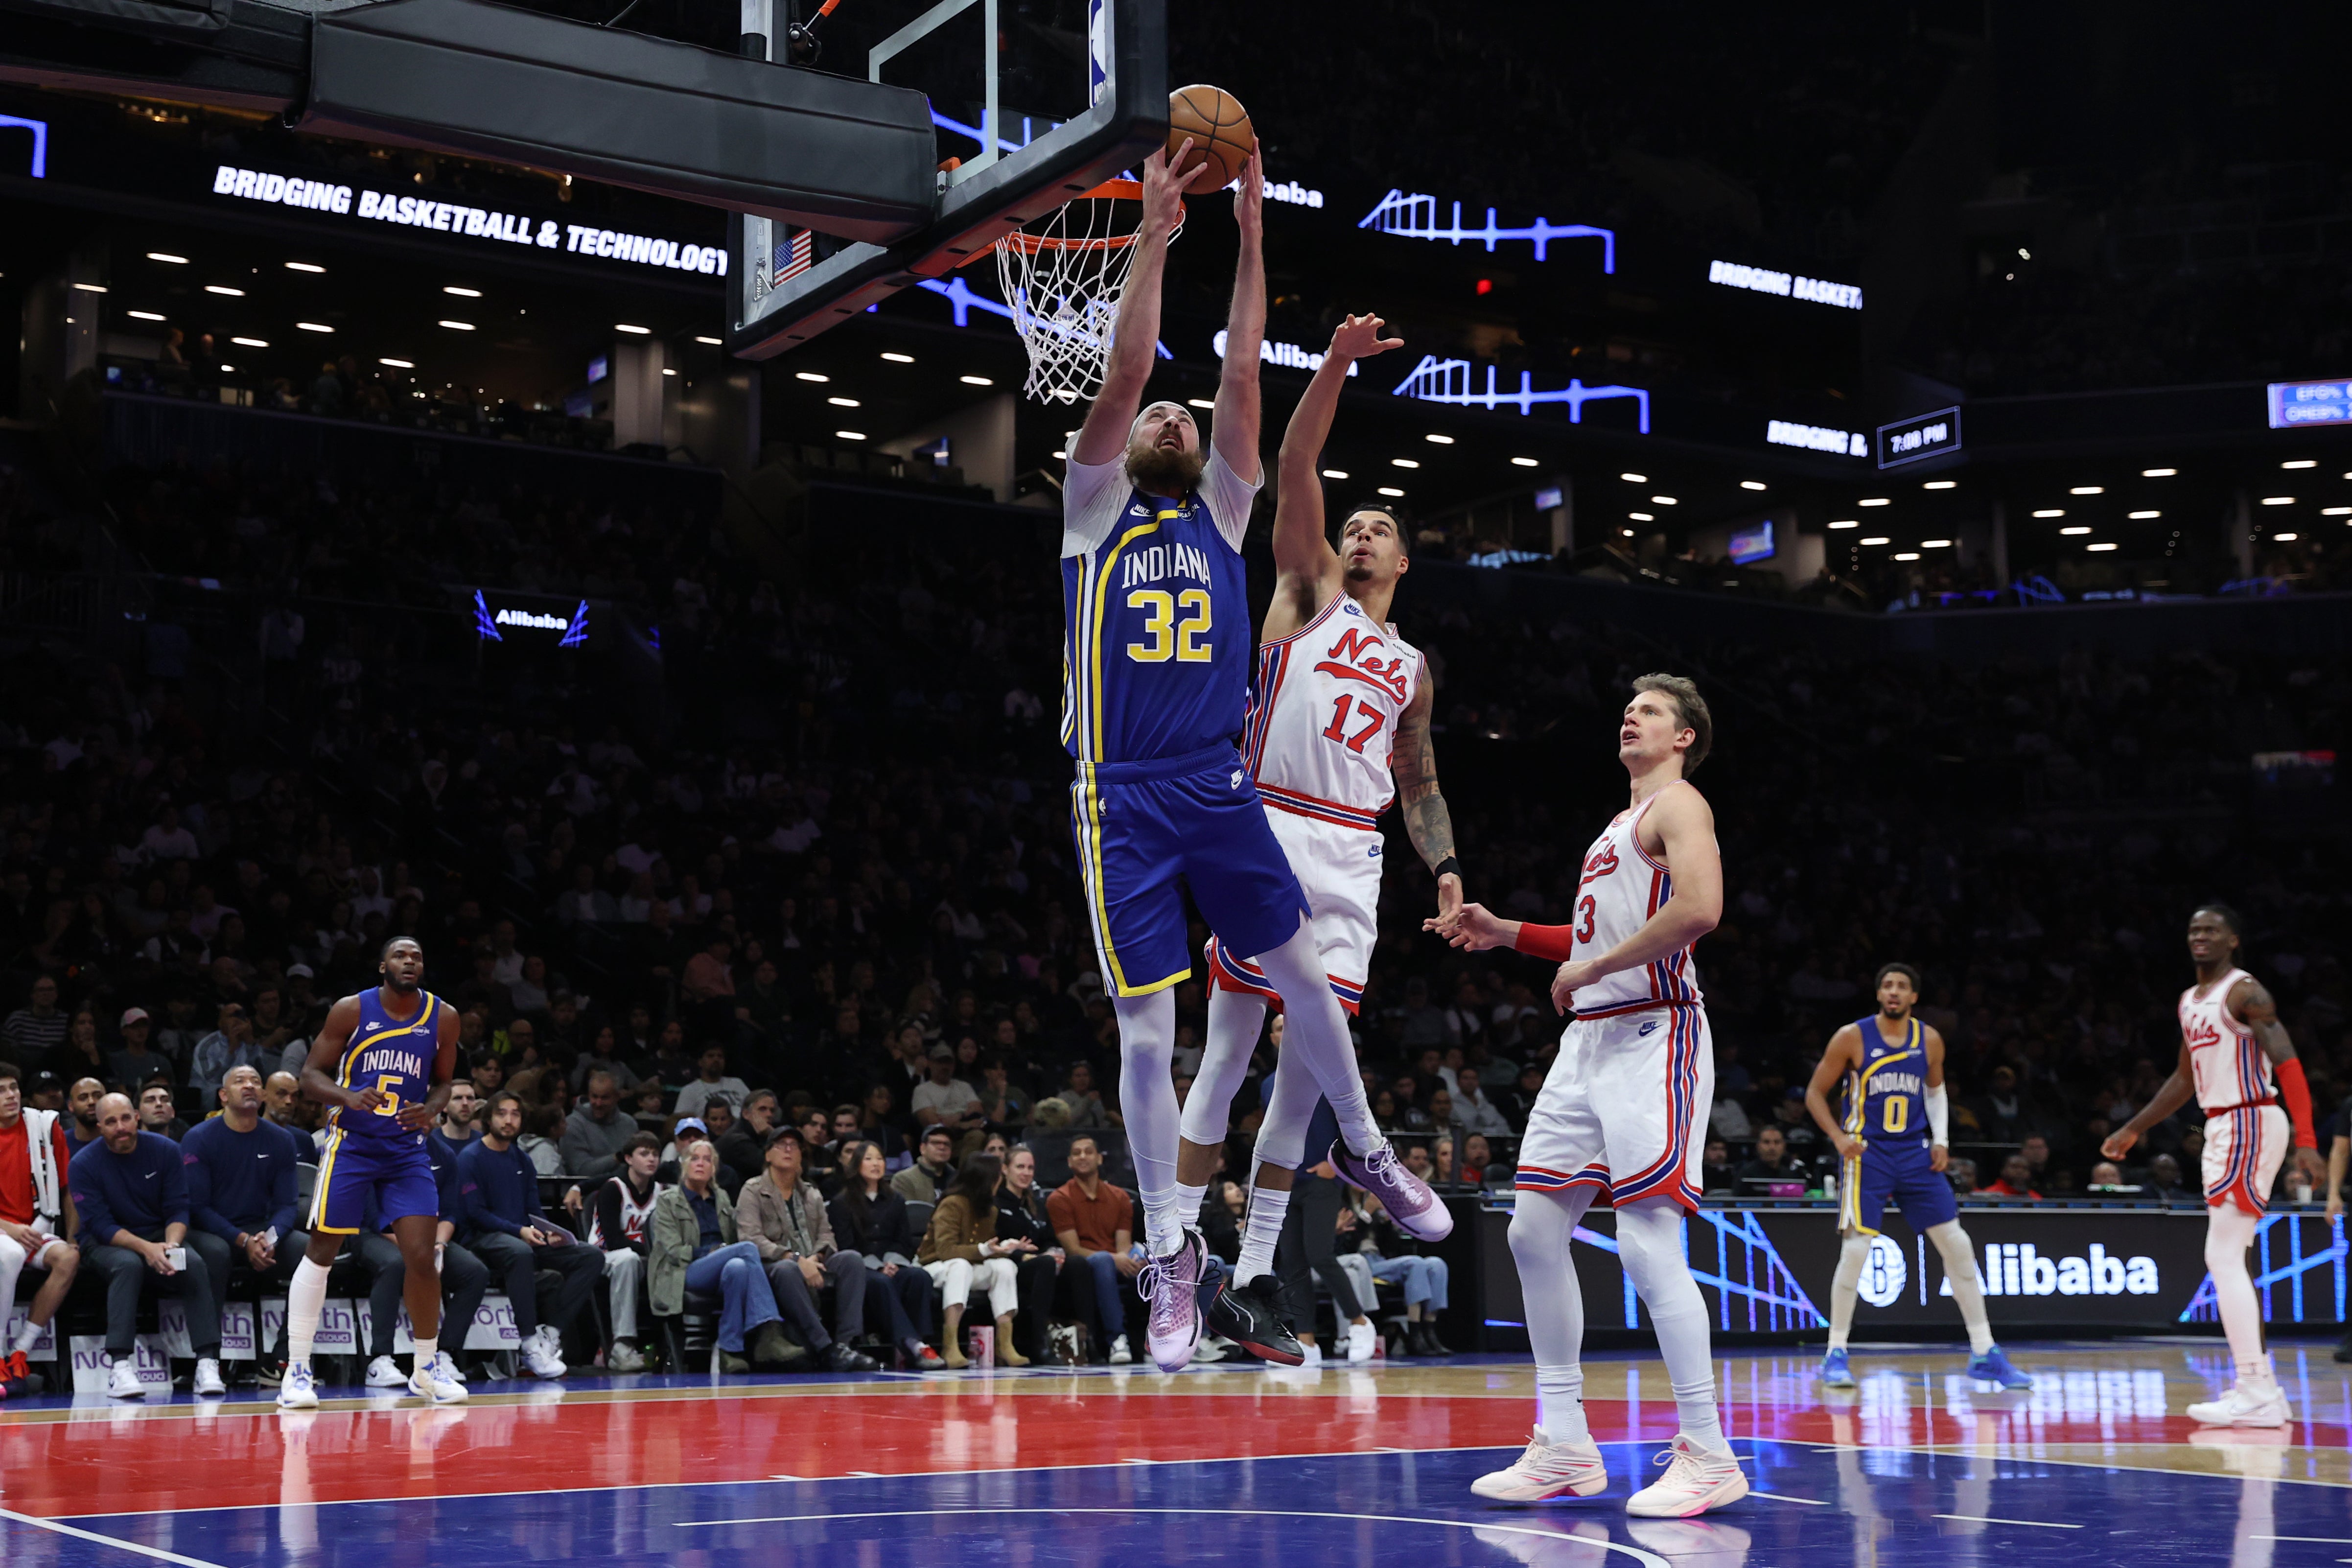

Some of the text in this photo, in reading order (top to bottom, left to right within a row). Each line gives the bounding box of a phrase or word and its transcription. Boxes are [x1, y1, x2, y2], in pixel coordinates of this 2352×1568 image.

[1221, 175, 1324, 209] baba
[212, 165, 728, 277] BRIDGING BASKETBALL & TECHNOLOGY
[1259, 339, 1358, 377] Aliba
[1923, 422, 1948, 445] PM
[1134, 503, 1150, 515] NIKE
[1191, 503, 1200, 513] OIL
[1122, 542, 1212, 590] INDIANA
[495, 608, 568, 630] Alibaba
[1347, 603, 1362, 615] NIKE
[1127, 588, 1213, 663] 32
[1327, 628, 1407, 703] Nets
[1322, 693, 1386, 755] 17
[1230, 769, 1242, 784] NIKE
[1572, 894, 1596, 944] 3
[1642, 1021, 1658, 1030] NIKE
[361, 1049, 422, 1079] INDIANA
[373, 1074, 404, 1117] 5
[1868, 1072, 1921, 1097] INDIANA
[1883, 1095, 1909, 1133] 0
[265, 1307, 350, 1329] Nth
